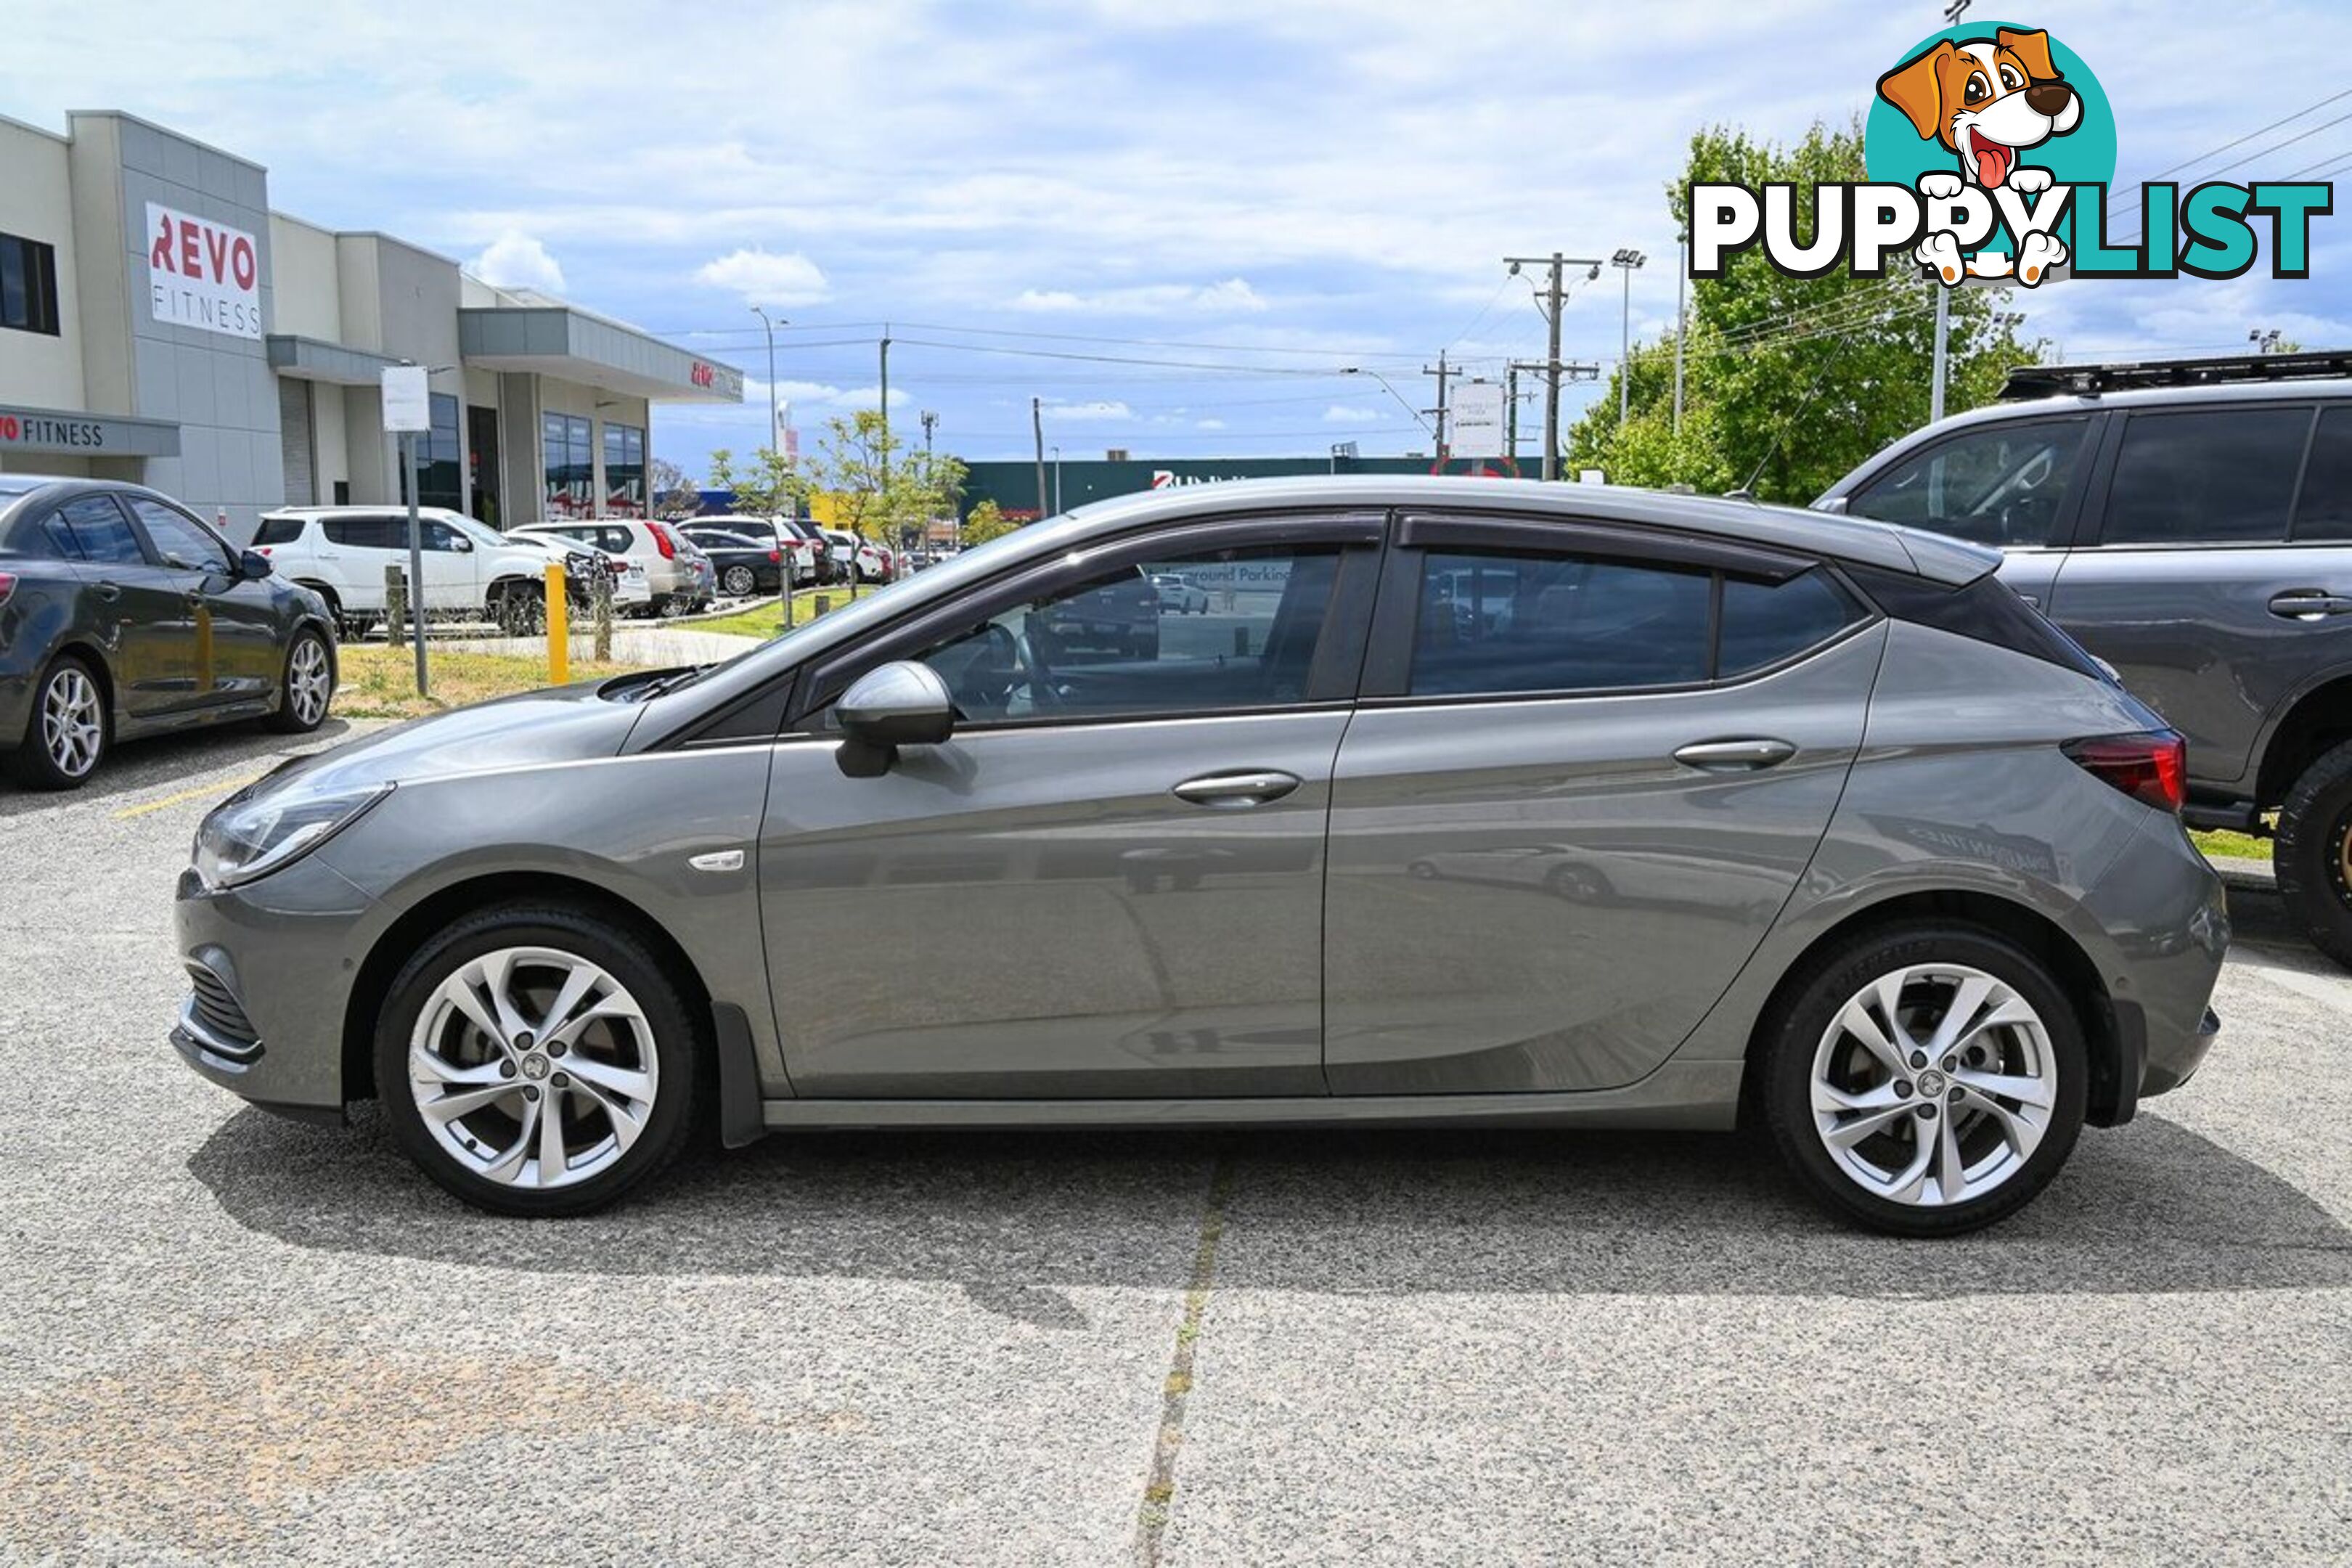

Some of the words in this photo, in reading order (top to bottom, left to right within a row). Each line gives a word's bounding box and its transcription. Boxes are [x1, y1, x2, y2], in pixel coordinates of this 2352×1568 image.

[152, 213, 255, 291] REVO
[153, 285, 260, 334] FITNESS
[23, 419, 103, 446] FITNESS
